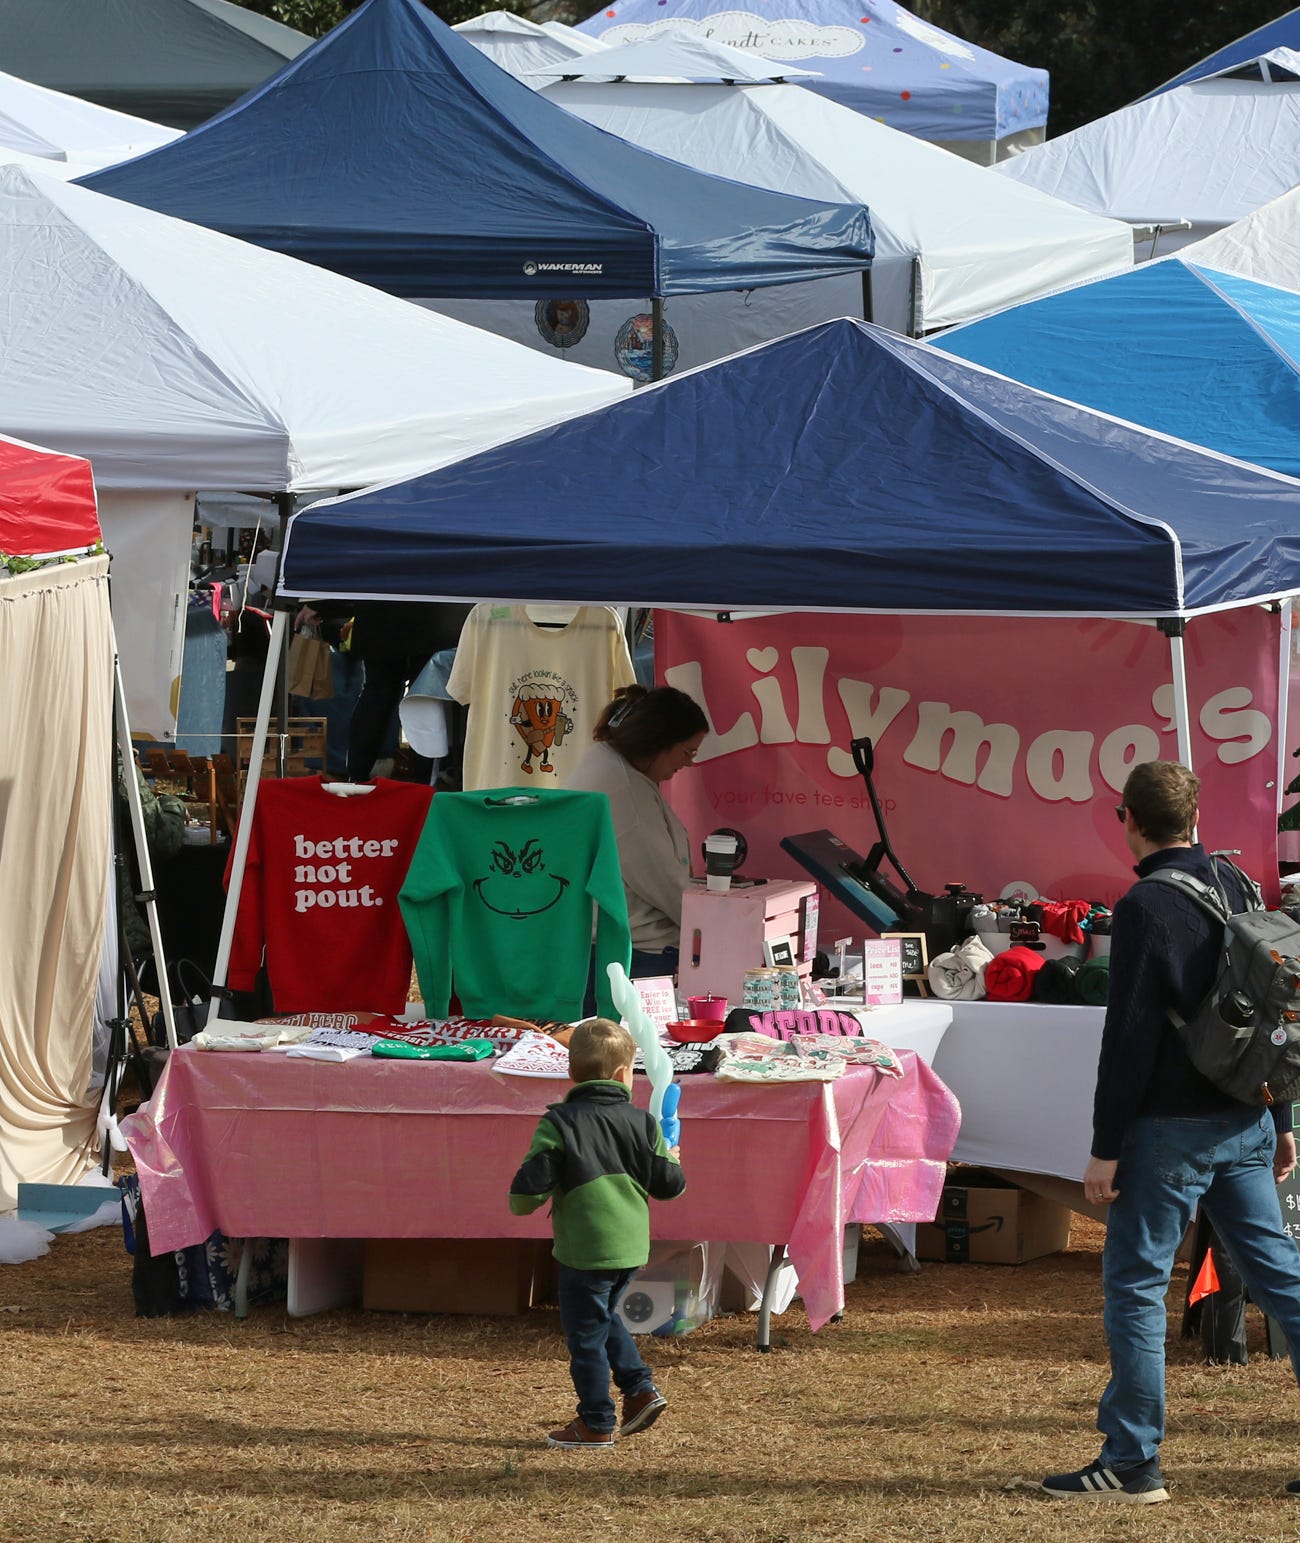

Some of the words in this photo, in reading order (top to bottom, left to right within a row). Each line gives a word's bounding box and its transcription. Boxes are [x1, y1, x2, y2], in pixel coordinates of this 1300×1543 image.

[770, 37, 833, 46] CAKES
[538, 263, 603, 271] WAKEMAN
[712, 790, 755, 809] your
[764, 784, 807, 806] fave
[813, 789, 845, 807] tee
[293, 834, 399, 859] better
[294, 861, 352, 883] not
[294, 884, 384, 913] pout.
[642, 1006, 660, 1014] FREE
[436, 1022, 525, 1040] MERRY
